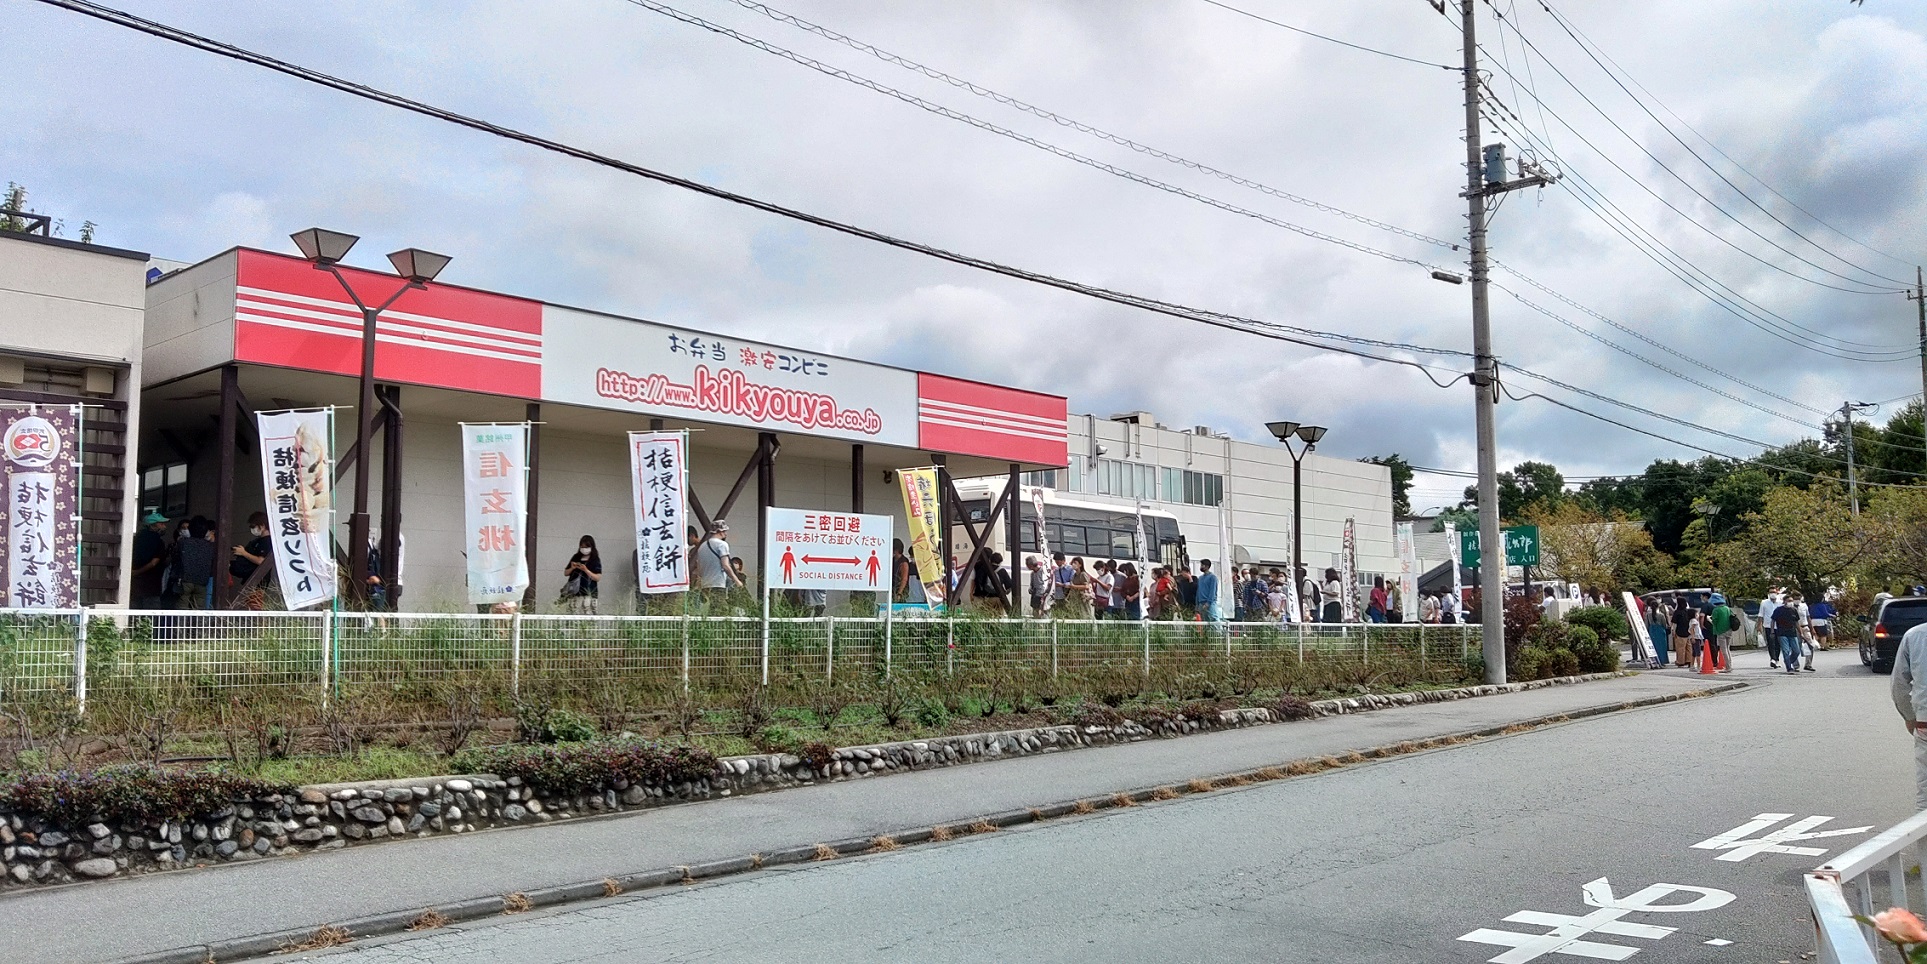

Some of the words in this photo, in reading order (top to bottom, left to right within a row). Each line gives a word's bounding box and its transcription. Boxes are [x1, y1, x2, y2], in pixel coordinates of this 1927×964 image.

[668, 333, 727, 362] お弁当
[740, 347, 829, 376] 激安コンビニ
[597, 365, 882, 434] http://www.kikyouya.co.jp
[643, 447, 683, 579] 桔梗信玄餅
[804, 515, 861, 533] 三密回避
[776, 531, 885, 547] 間隔をあけてお並びください
[829, 572, 863, 580] DISTANCE
